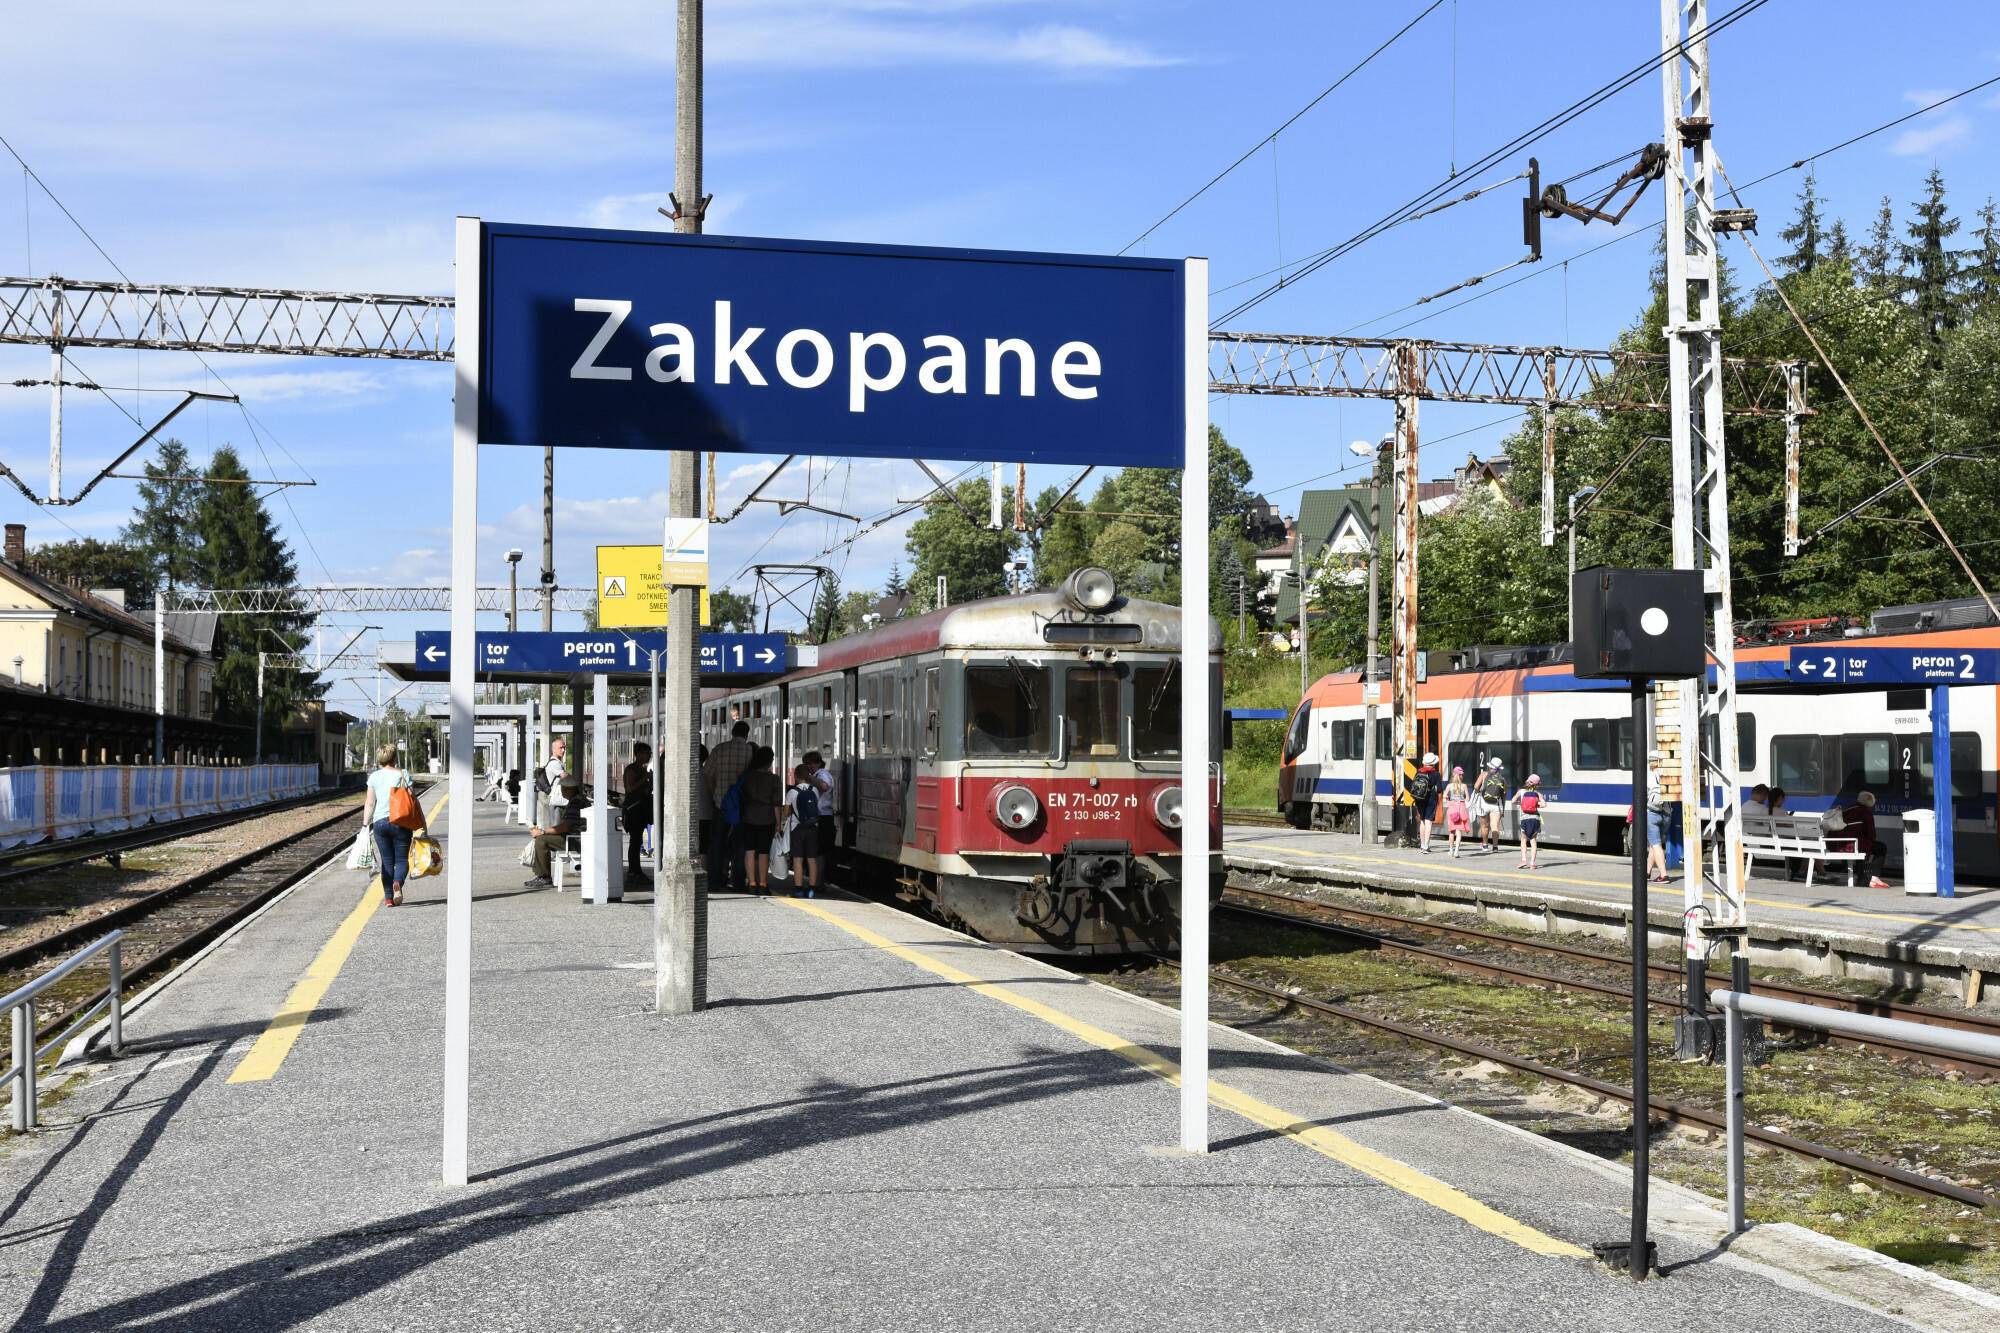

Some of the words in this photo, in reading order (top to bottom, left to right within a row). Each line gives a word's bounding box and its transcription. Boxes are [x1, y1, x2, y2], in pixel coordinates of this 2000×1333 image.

[569, 297, 1102, 413] Zakopane
[486, 643, 509, 655] tor
[564, 641, 615, 657] peron
[623, 639, 636, 666] 1
[700, 646, 716, 657] or
[732, 644, 744, 667] 1
[580, 657, 615, 665] platform
[700, 658, 717, 666] track
[1823, 656, 1837, 678] 2
[1849, 657, 1867, 669] tor
[1912, 655, 1954, 670] peron
[1959, 654, 1975, 679] 2
[1925, 669, 1954, 678] platform
[1480, 751, 1484, 768] 2
[1902, 747, 1911, 770] 2
[1048, 793, 1066, 807] EN
[1072, 793, 1119, 807] 71-007
[1124, 793, 1138, 808] rb
[1064, 810, 1071, 820] 2
[1073, 810, 1089, 820] 130
